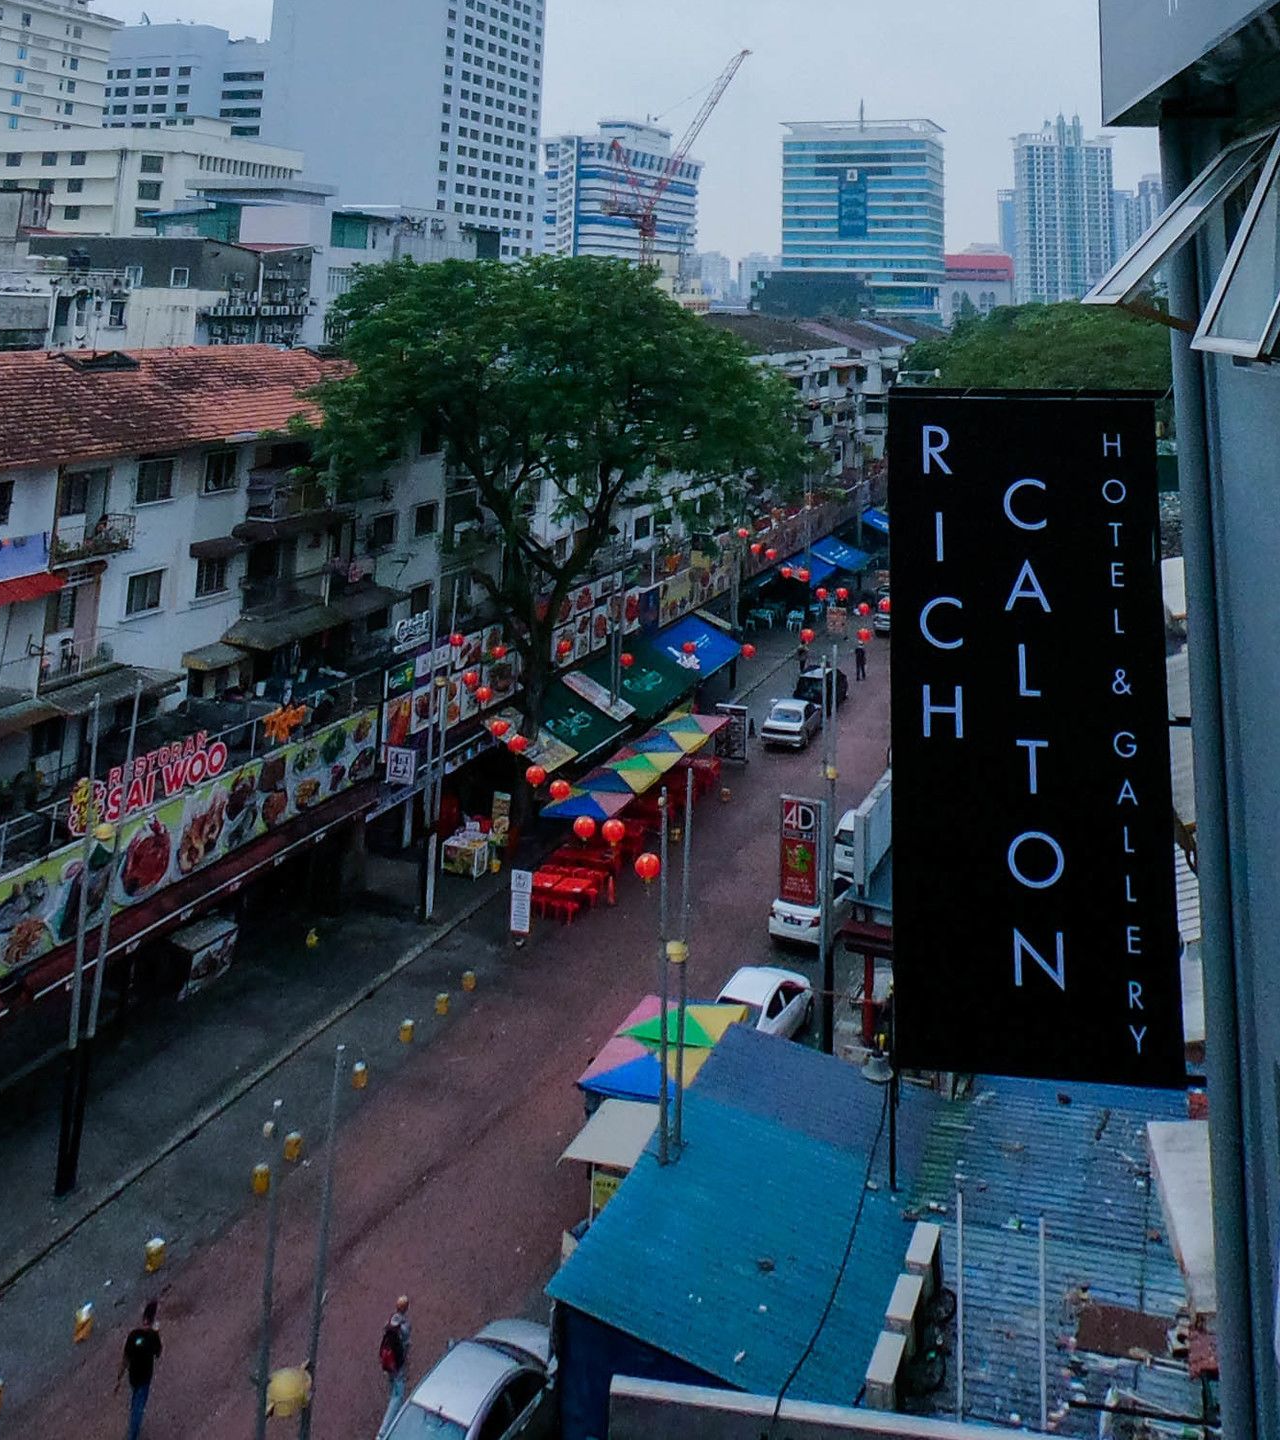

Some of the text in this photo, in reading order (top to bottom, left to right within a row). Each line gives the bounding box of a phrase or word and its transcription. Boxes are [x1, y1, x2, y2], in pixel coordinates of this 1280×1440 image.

[921, 425, 963, 738] RICH
[1003, 478, 1065, 992] CALTON
[105, 772, 156, 823] SAI
[162, 741, 227, 797] WOO
[784, 805, 816, 831] 4D
[1102, 433, 1147, 1054] HOTEL & GALLERY
